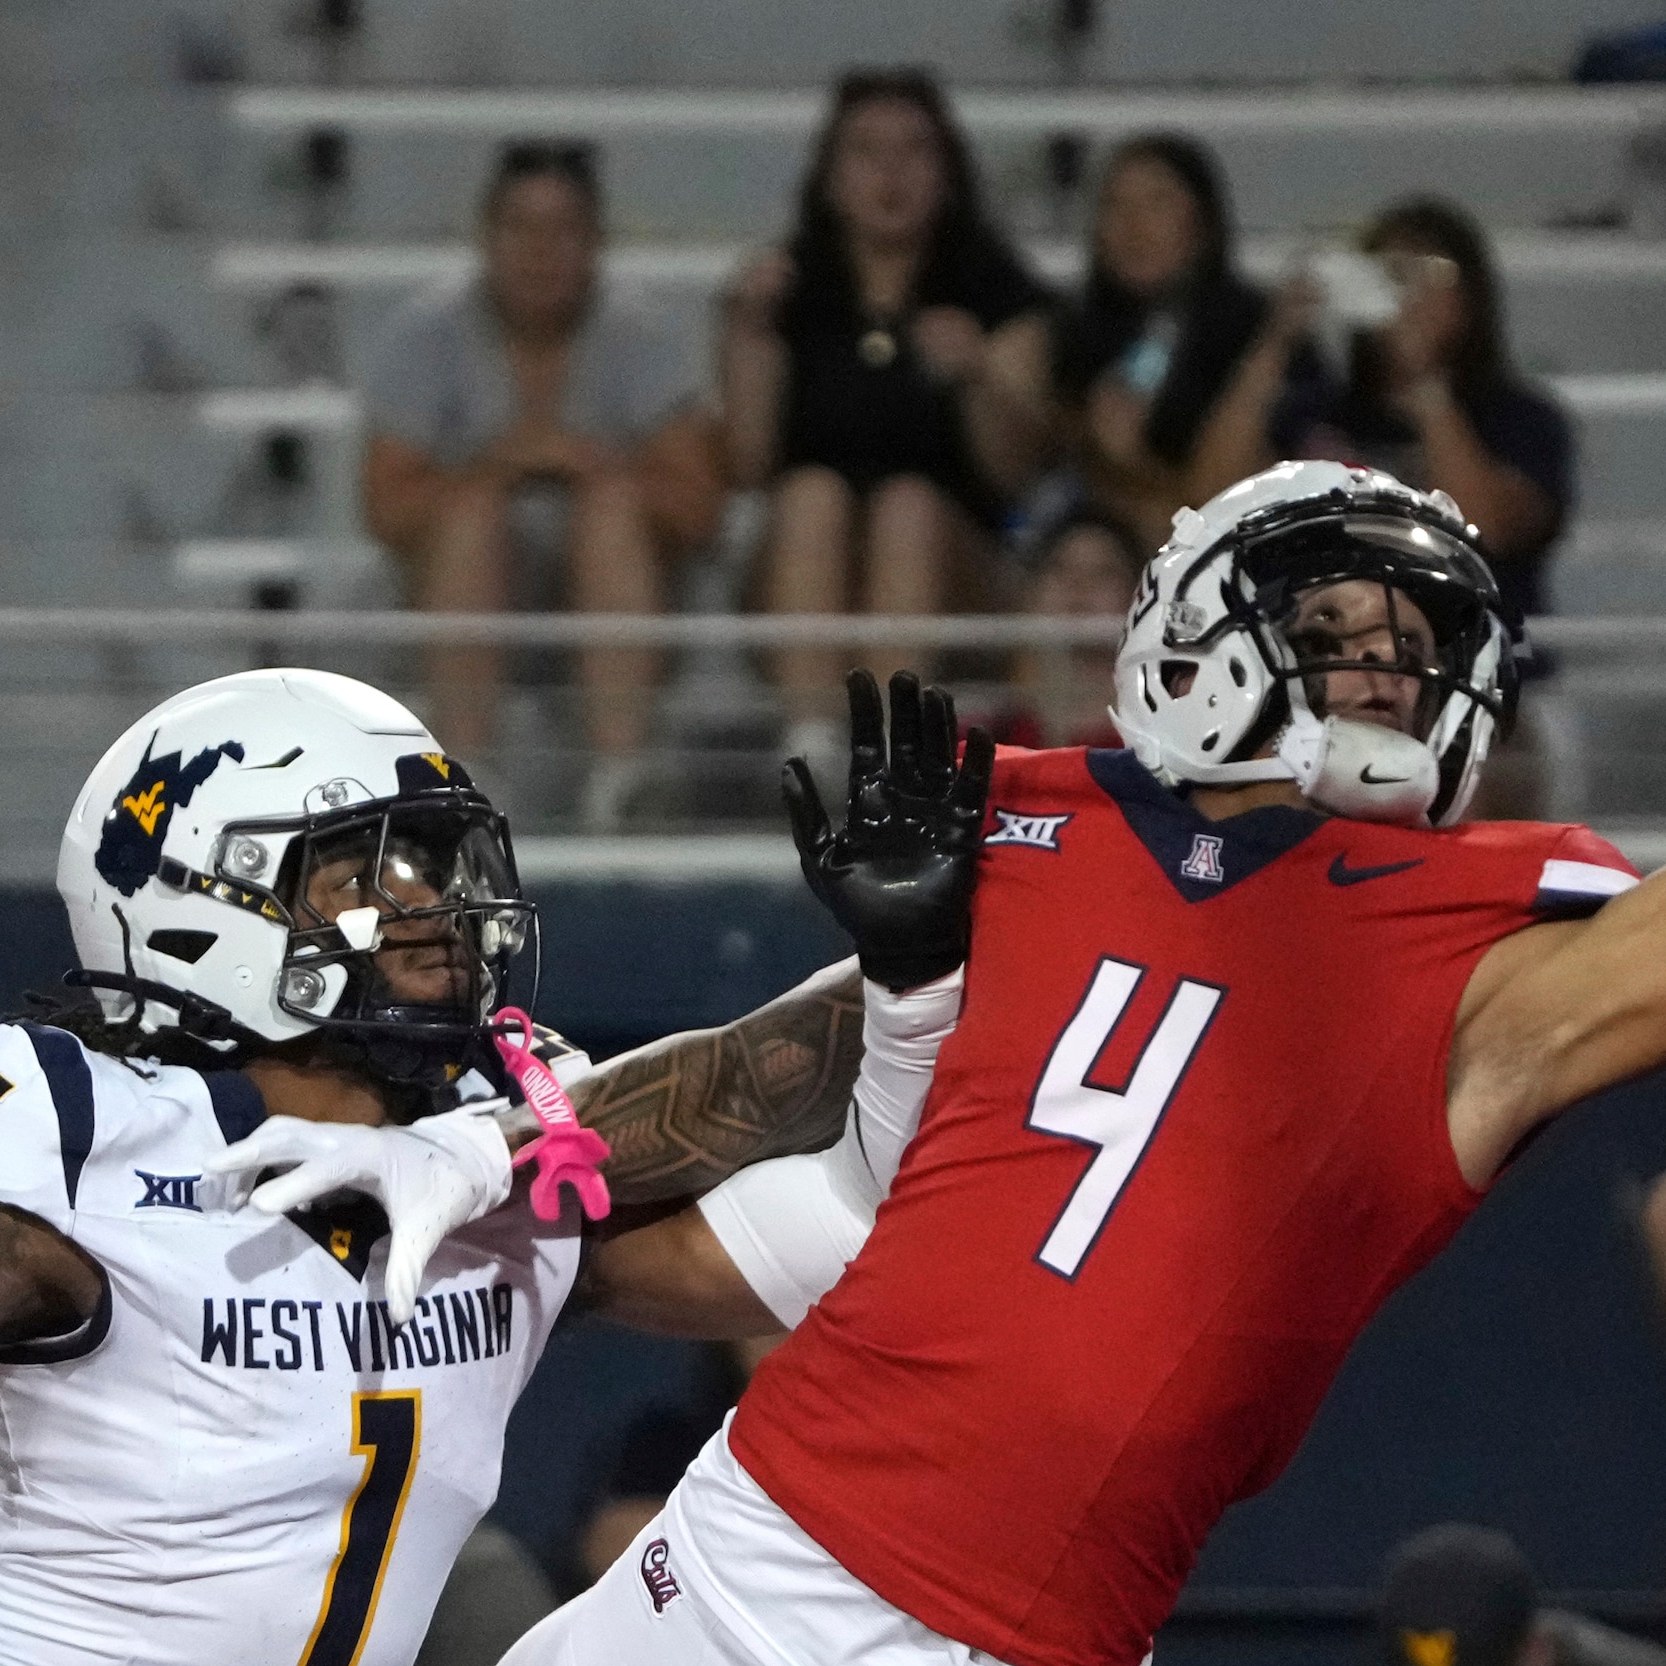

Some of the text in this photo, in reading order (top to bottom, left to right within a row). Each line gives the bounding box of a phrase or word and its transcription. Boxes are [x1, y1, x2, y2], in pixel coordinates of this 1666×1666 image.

[984, 810, 1071, 850] XII
[1181, 833, 1224, 882] A
[522, 1065, 573, 1124] NXTRND
[1023, 951, 1229, 1284] 4
[134, 1168, 203, 1213] XII
[200, 1297, 324, 1372] WEST
